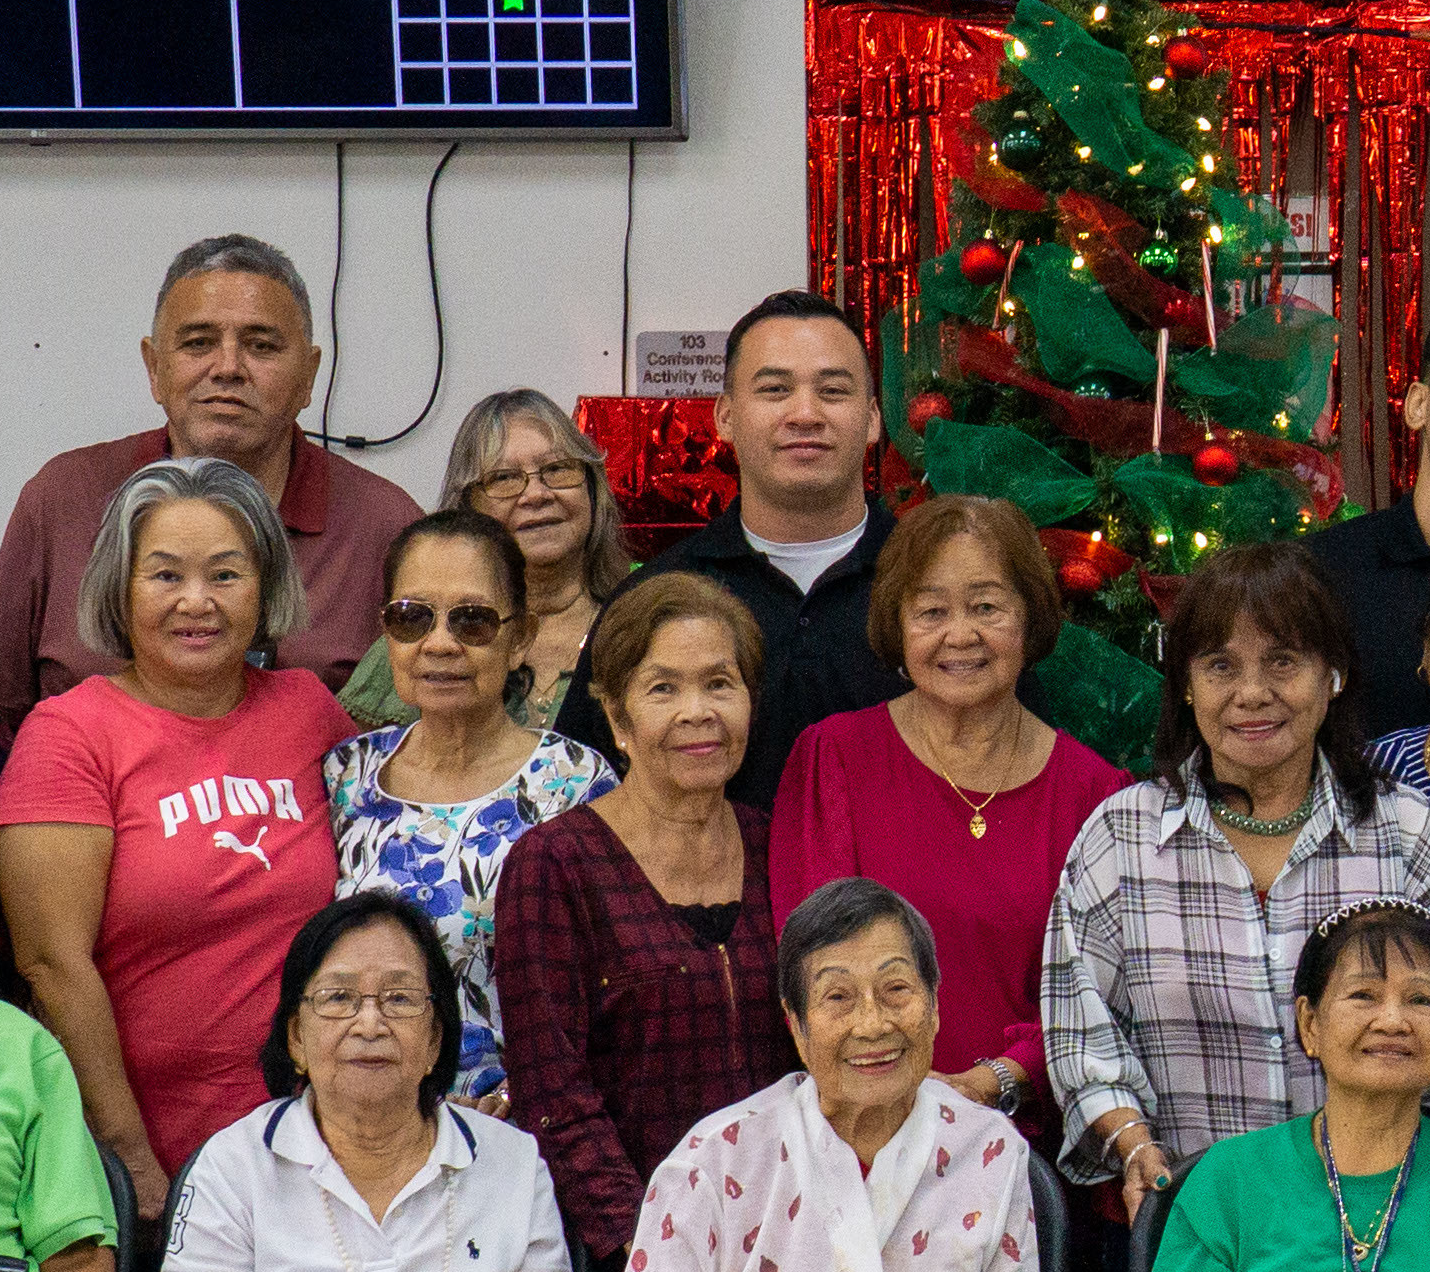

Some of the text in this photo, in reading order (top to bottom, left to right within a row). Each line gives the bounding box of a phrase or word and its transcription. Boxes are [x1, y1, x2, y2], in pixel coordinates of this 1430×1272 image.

[680, 335, 706, 349] 103
[643, 369, 697, 385] Activity
[158, 775, 303, 839] PUMA
